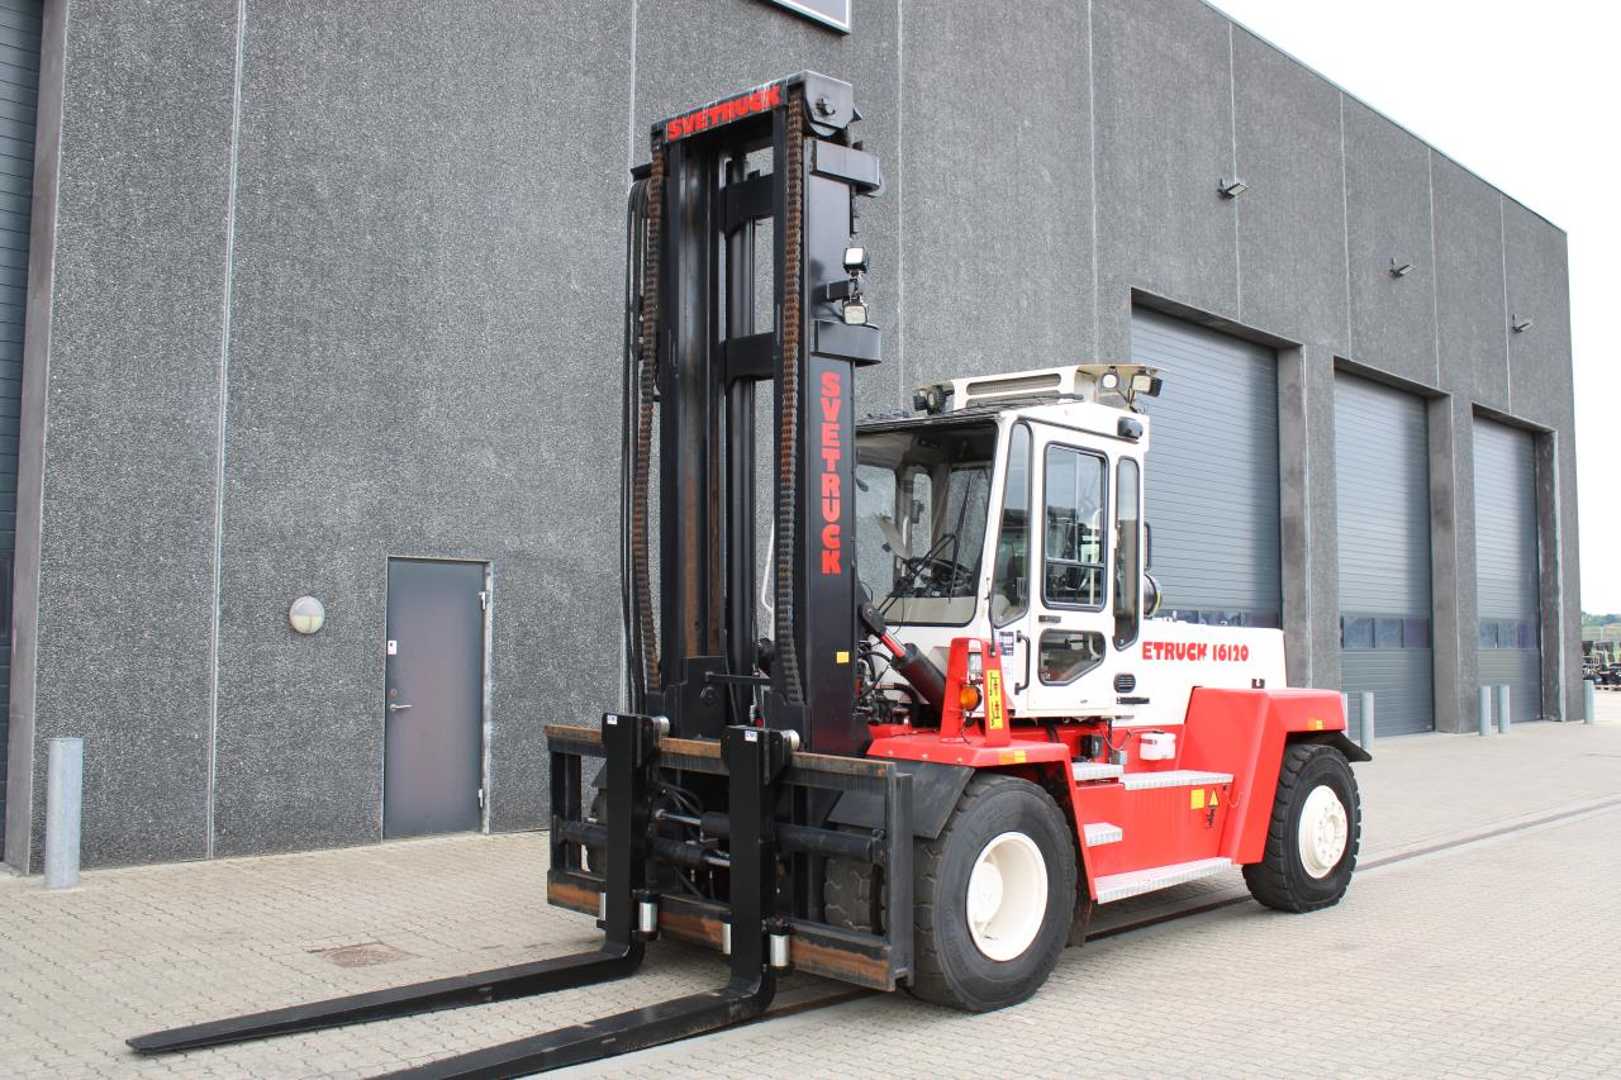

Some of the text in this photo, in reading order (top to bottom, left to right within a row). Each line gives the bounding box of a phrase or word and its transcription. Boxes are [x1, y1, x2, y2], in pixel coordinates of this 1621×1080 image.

[667, 84, 781, 141] SVETRUCK
[820, 371, 842, 575] SVETRUCK
[1212, 644, 1249, 661] 16120
